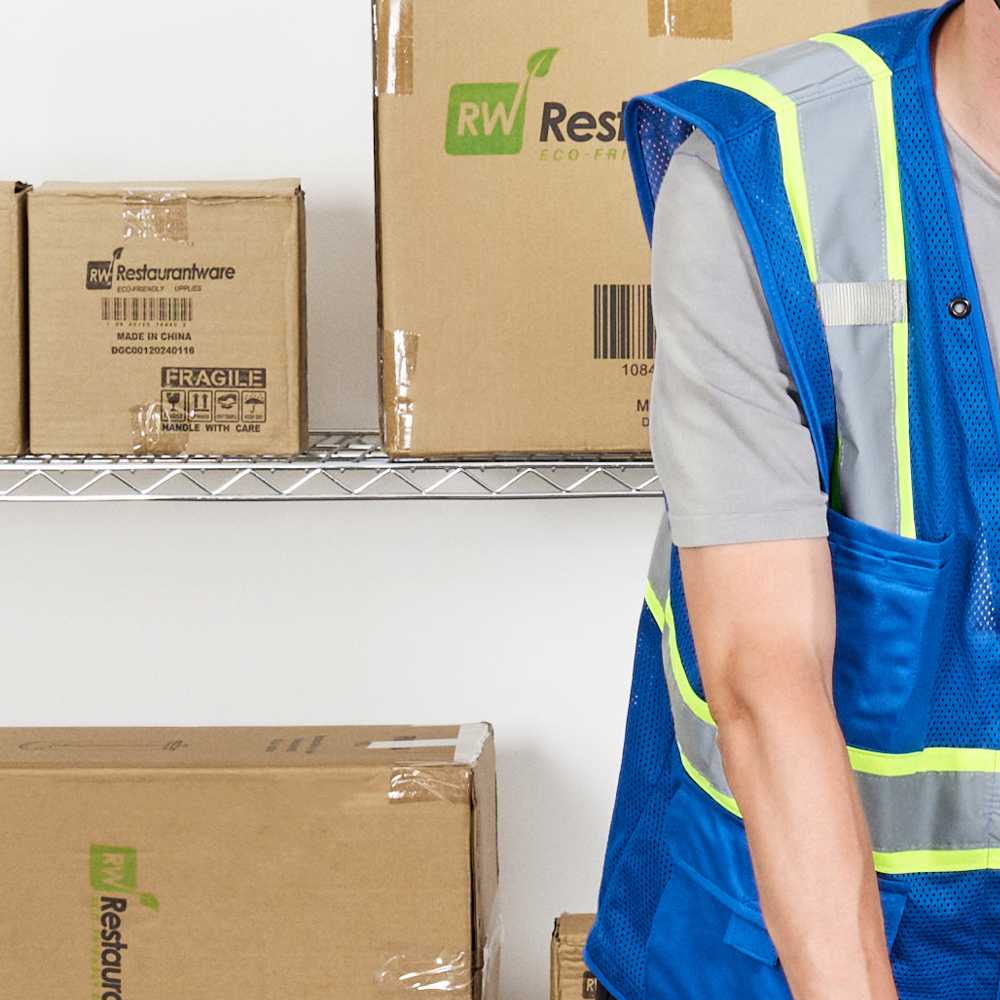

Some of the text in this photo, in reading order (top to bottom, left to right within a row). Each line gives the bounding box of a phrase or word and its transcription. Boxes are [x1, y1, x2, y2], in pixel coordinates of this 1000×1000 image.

[457, 101, 517, 136] RW
[89, 263, 236, 282] RW Restaurantware
[117, 332, 192, 341] MADE IN CHINA
[166, 368, 263, 386] FRAGILE
[162, 423, 261, 433] HANDLE WITH CARE
[102, 852, 125, 886] RW
[586, 978, 597, 992] R
